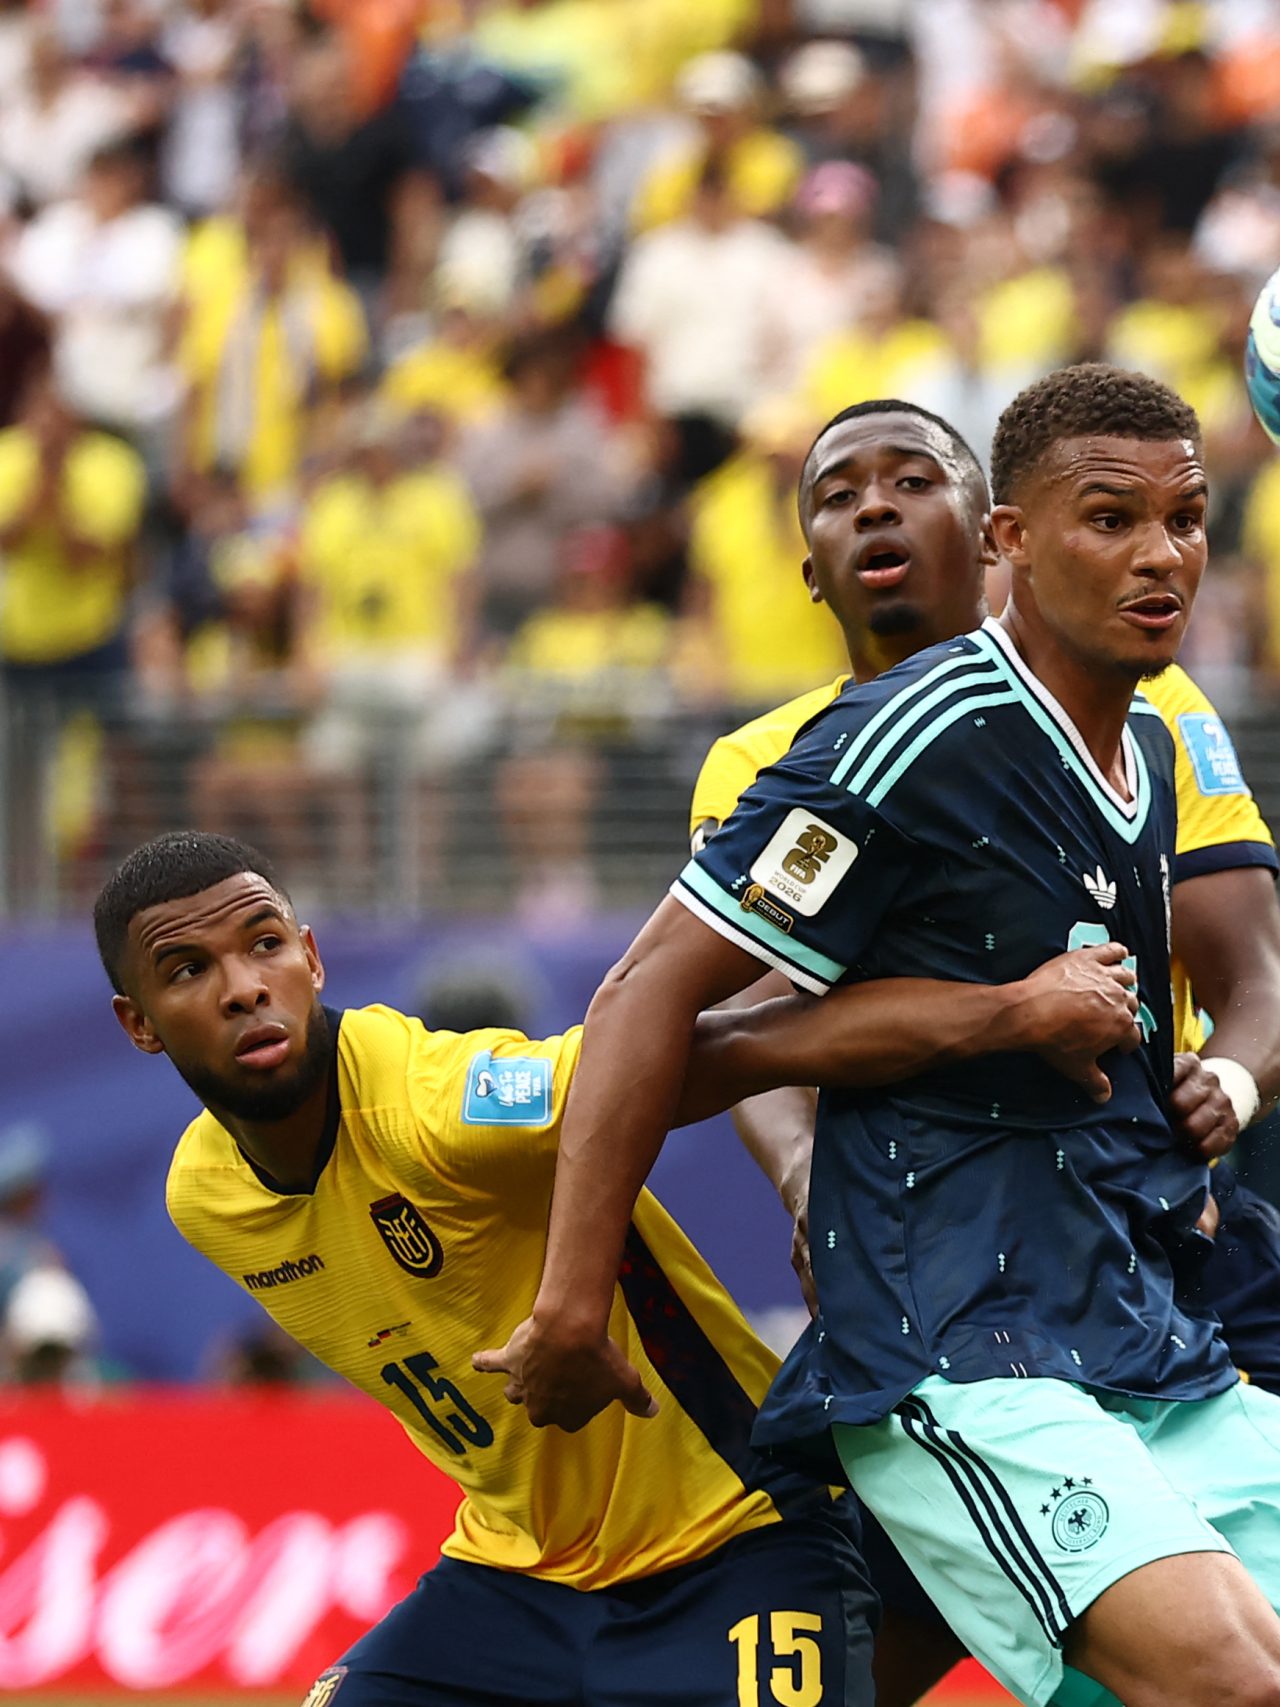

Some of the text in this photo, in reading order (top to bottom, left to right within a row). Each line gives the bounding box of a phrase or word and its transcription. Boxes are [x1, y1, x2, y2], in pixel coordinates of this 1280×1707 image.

[790, 863, 807, 879] FIFA
[768, 876, 803, 902] 2026
[757, 900, 789, 924] DEBUT
[514, 1071, 532, 1104] PEACE
[243, 1254, 325, 1290] marathon
[380, 1352, 494, 1454] 15
[728, 1610, 823, 1707] 15
